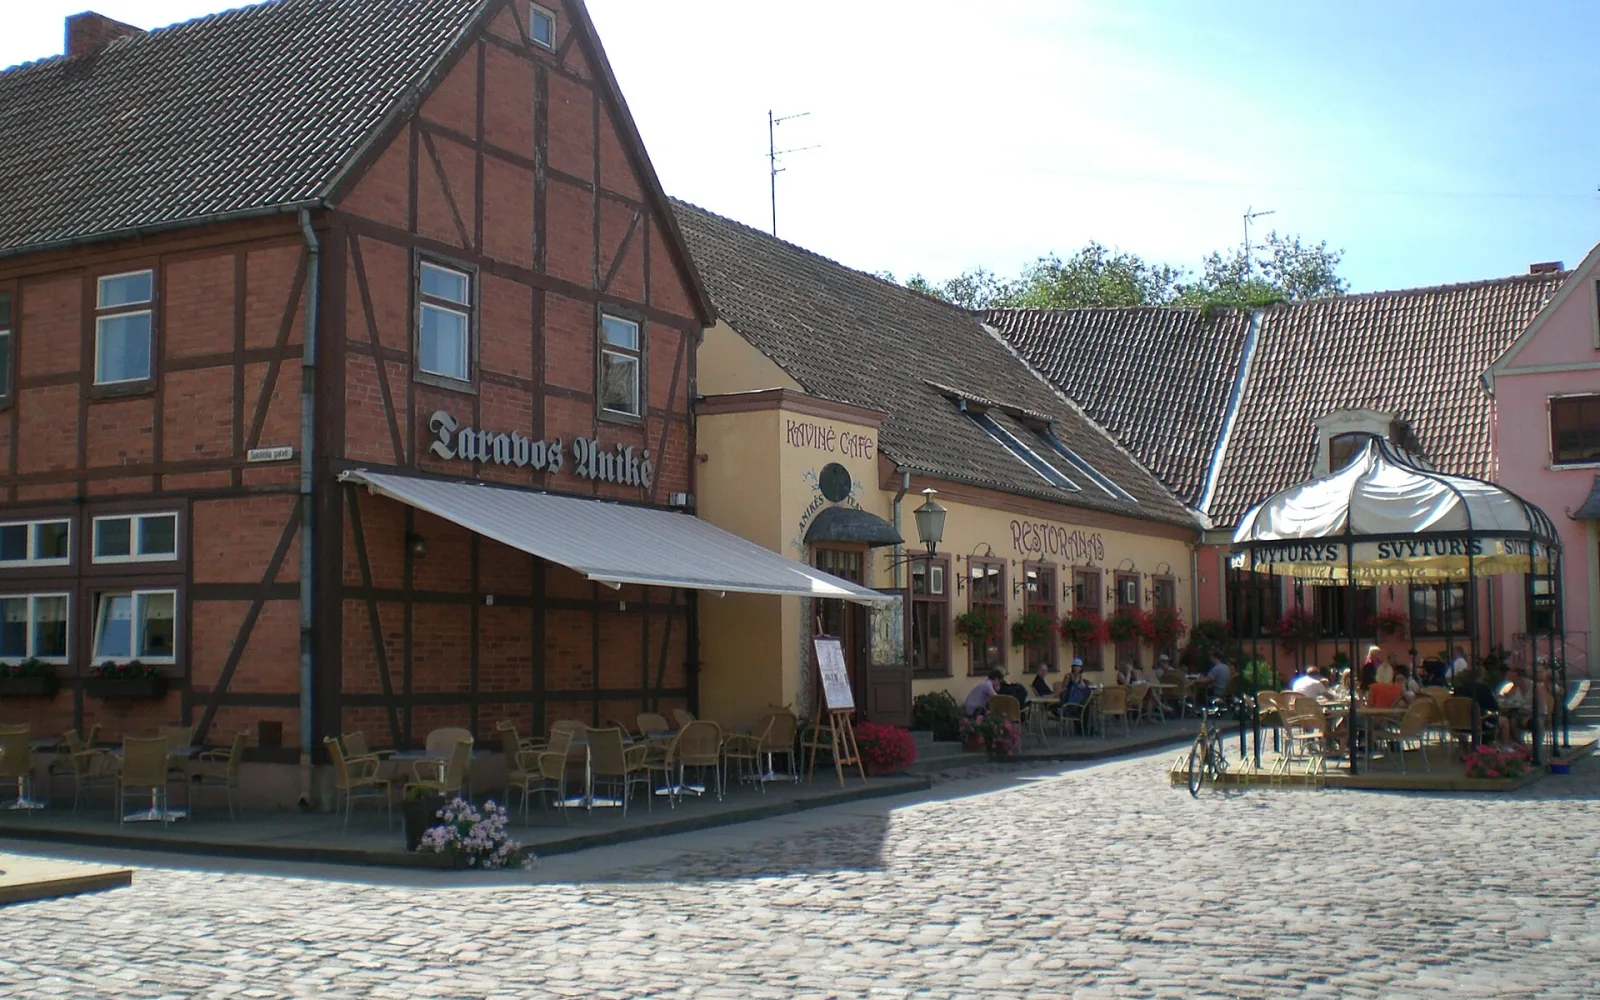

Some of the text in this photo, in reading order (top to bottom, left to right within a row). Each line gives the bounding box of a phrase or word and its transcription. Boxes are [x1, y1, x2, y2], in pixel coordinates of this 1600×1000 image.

[429, 410, 653, 488] Taravos Anikė
[1010, 520, 1104, 561] RESTORANAS
